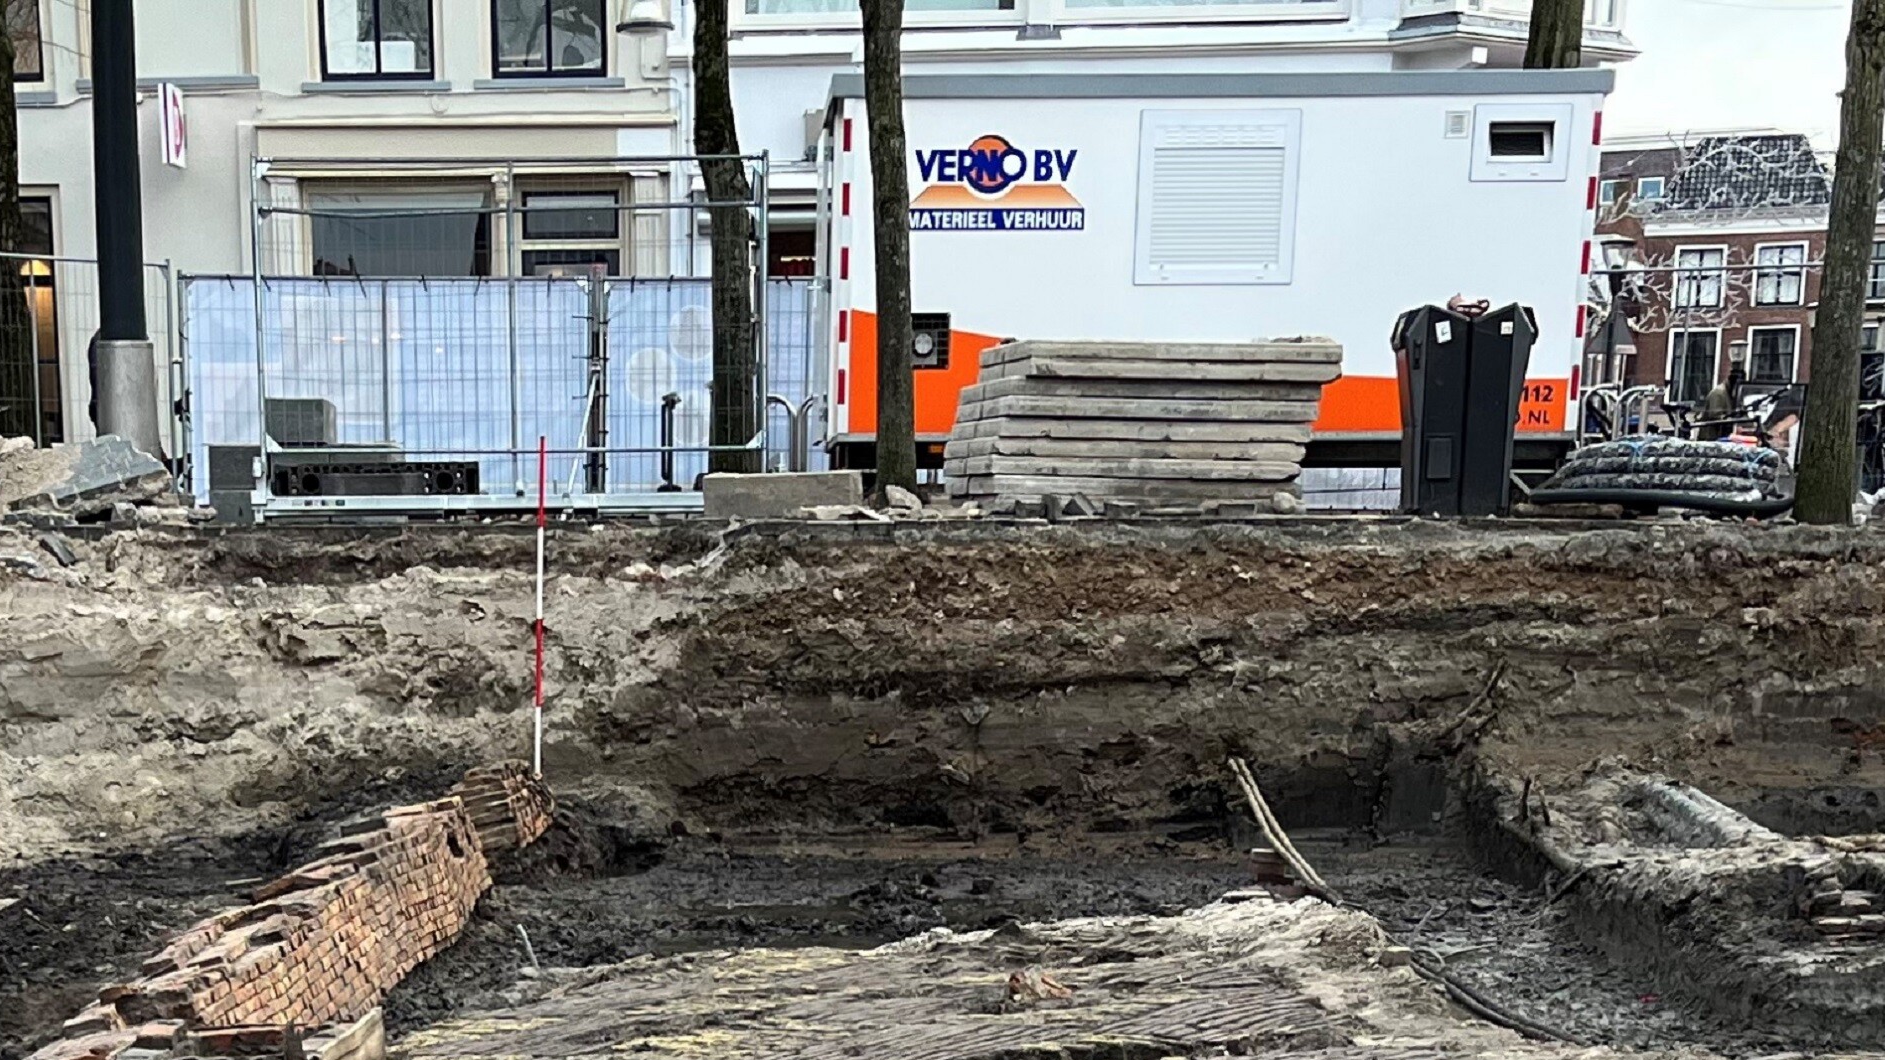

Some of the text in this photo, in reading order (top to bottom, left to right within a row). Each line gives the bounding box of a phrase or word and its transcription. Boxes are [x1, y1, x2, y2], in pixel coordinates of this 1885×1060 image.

[915, 149, 1078, 182] VERNO BV
[909, 211, 1083, 229] MATERIEEL VERHUUR
